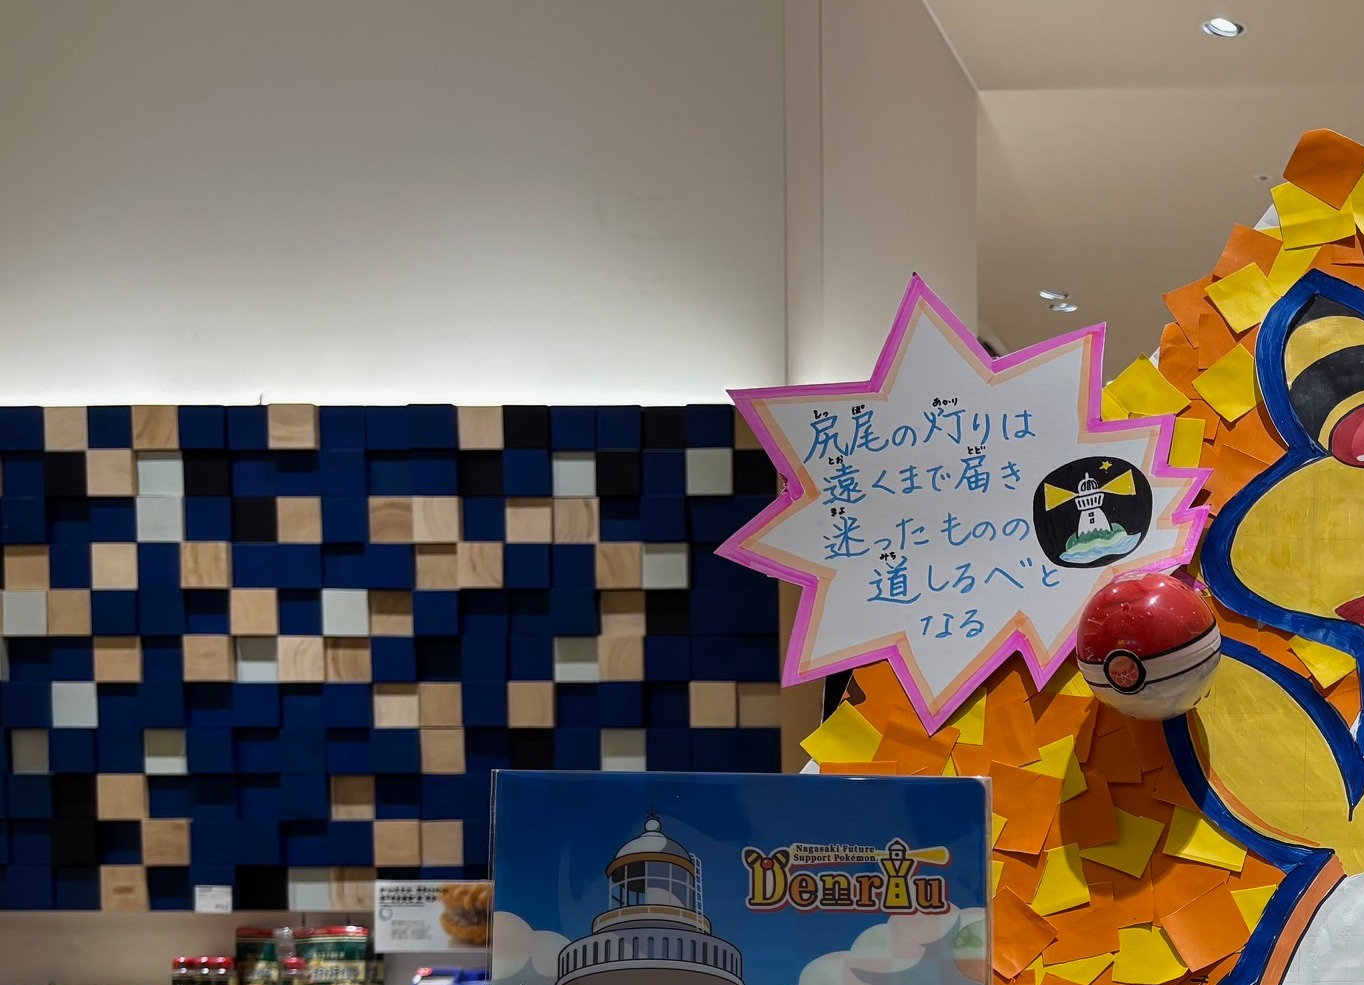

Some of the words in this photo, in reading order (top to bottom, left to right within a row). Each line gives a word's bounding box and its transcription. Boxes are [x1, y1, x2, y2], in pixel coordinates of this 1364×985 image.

[804, 407, 1036, 464] 尻尾の灯りは
[822, 455, 1022, 506] 遠くまで届き
[823, 513, 1030, 561] 迷ったものの
[868, 556, 1060, 604] 道しるべと
[921, 610, 985, 639] なる
[793, 853, 831, 864] Support
[795, 844, 840, 854] Nagasaki
[842, 844, 875, 854] Future
